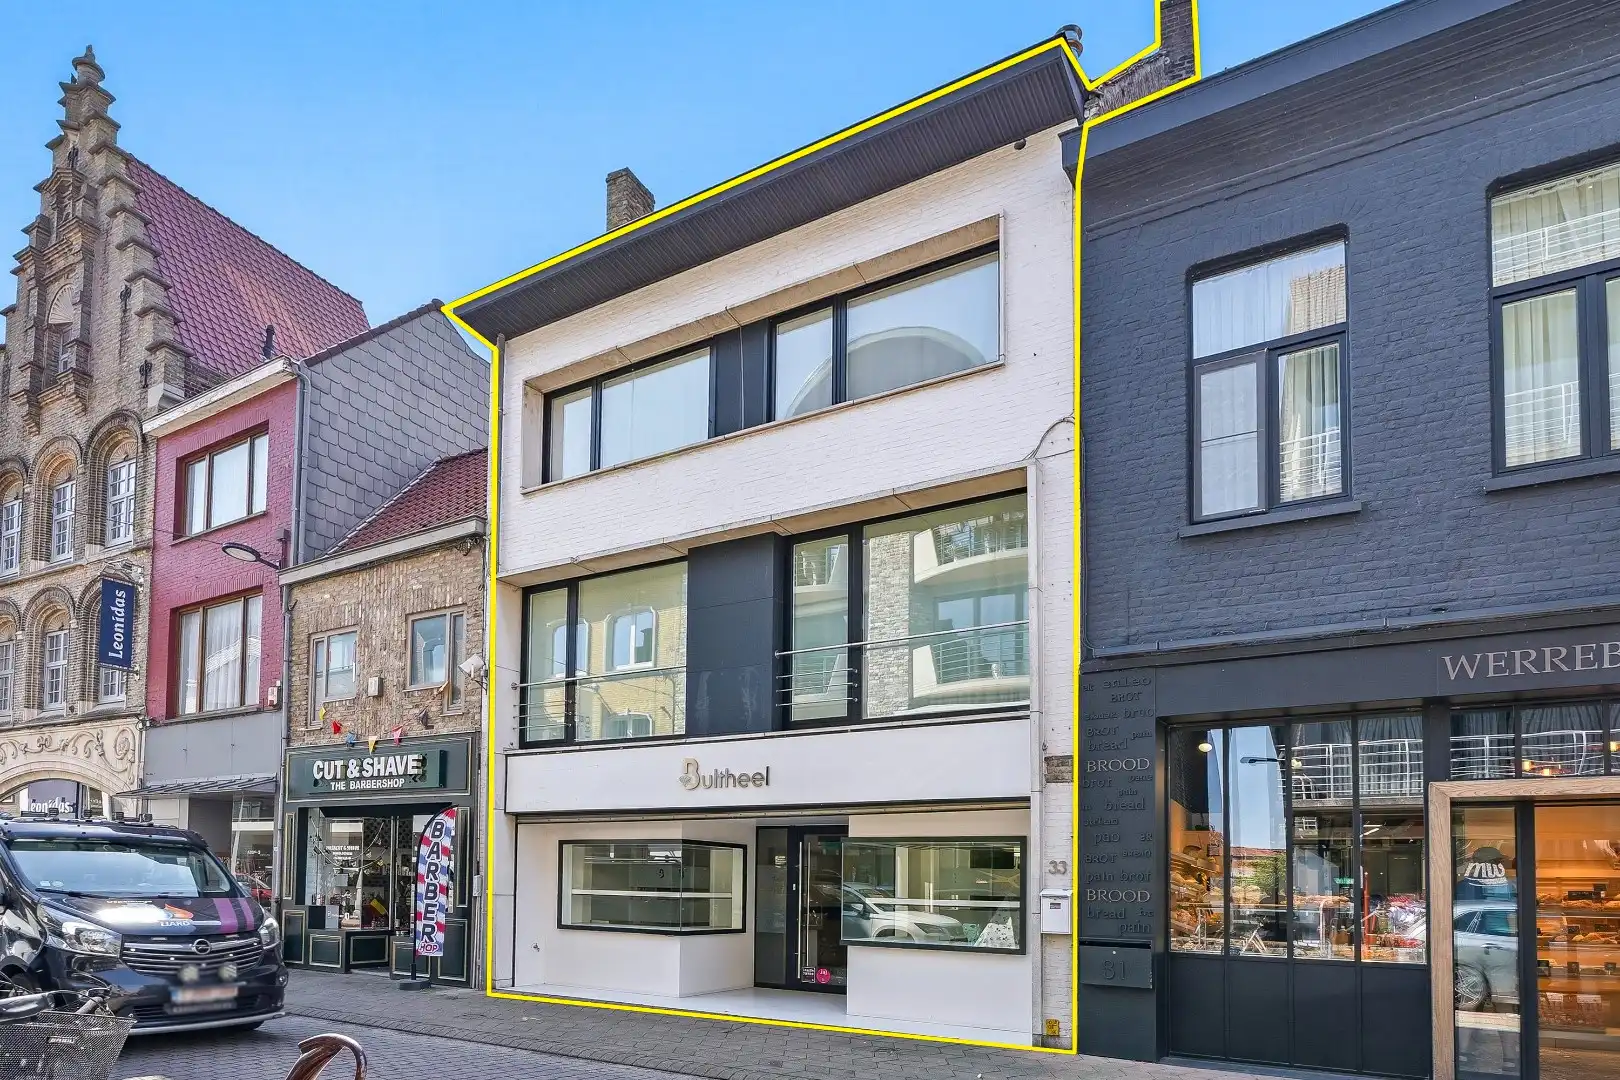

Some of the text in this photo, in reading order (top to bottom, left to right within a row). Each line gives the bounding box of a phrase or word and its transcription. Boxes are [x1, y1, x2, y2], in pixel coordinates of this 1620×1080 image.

[108, 589, 126, 659] Leonidas
[1441, 641, 1620, 681] WERREB
[1088, 737, 1128, 752] bread
[313, 754, 423, 780] CUT & SHAVE
[1086, 757, 1150, 772] BROOD
[679, 757, 770, 790] Bultheel
[330, 778, 405, 791] THE BARBERSHOP
[1105, 797, 1146, 811] bread
[1048, 860, 1067, 874] 33
[421, 820, 445, 943] BARBER
[1084, 871, 1115, 884] pain
[1086, 889, 1151, 903] BROOD
[1087, 905, 1126, 919] bread
[1119, 920, 1152, 936] pain
